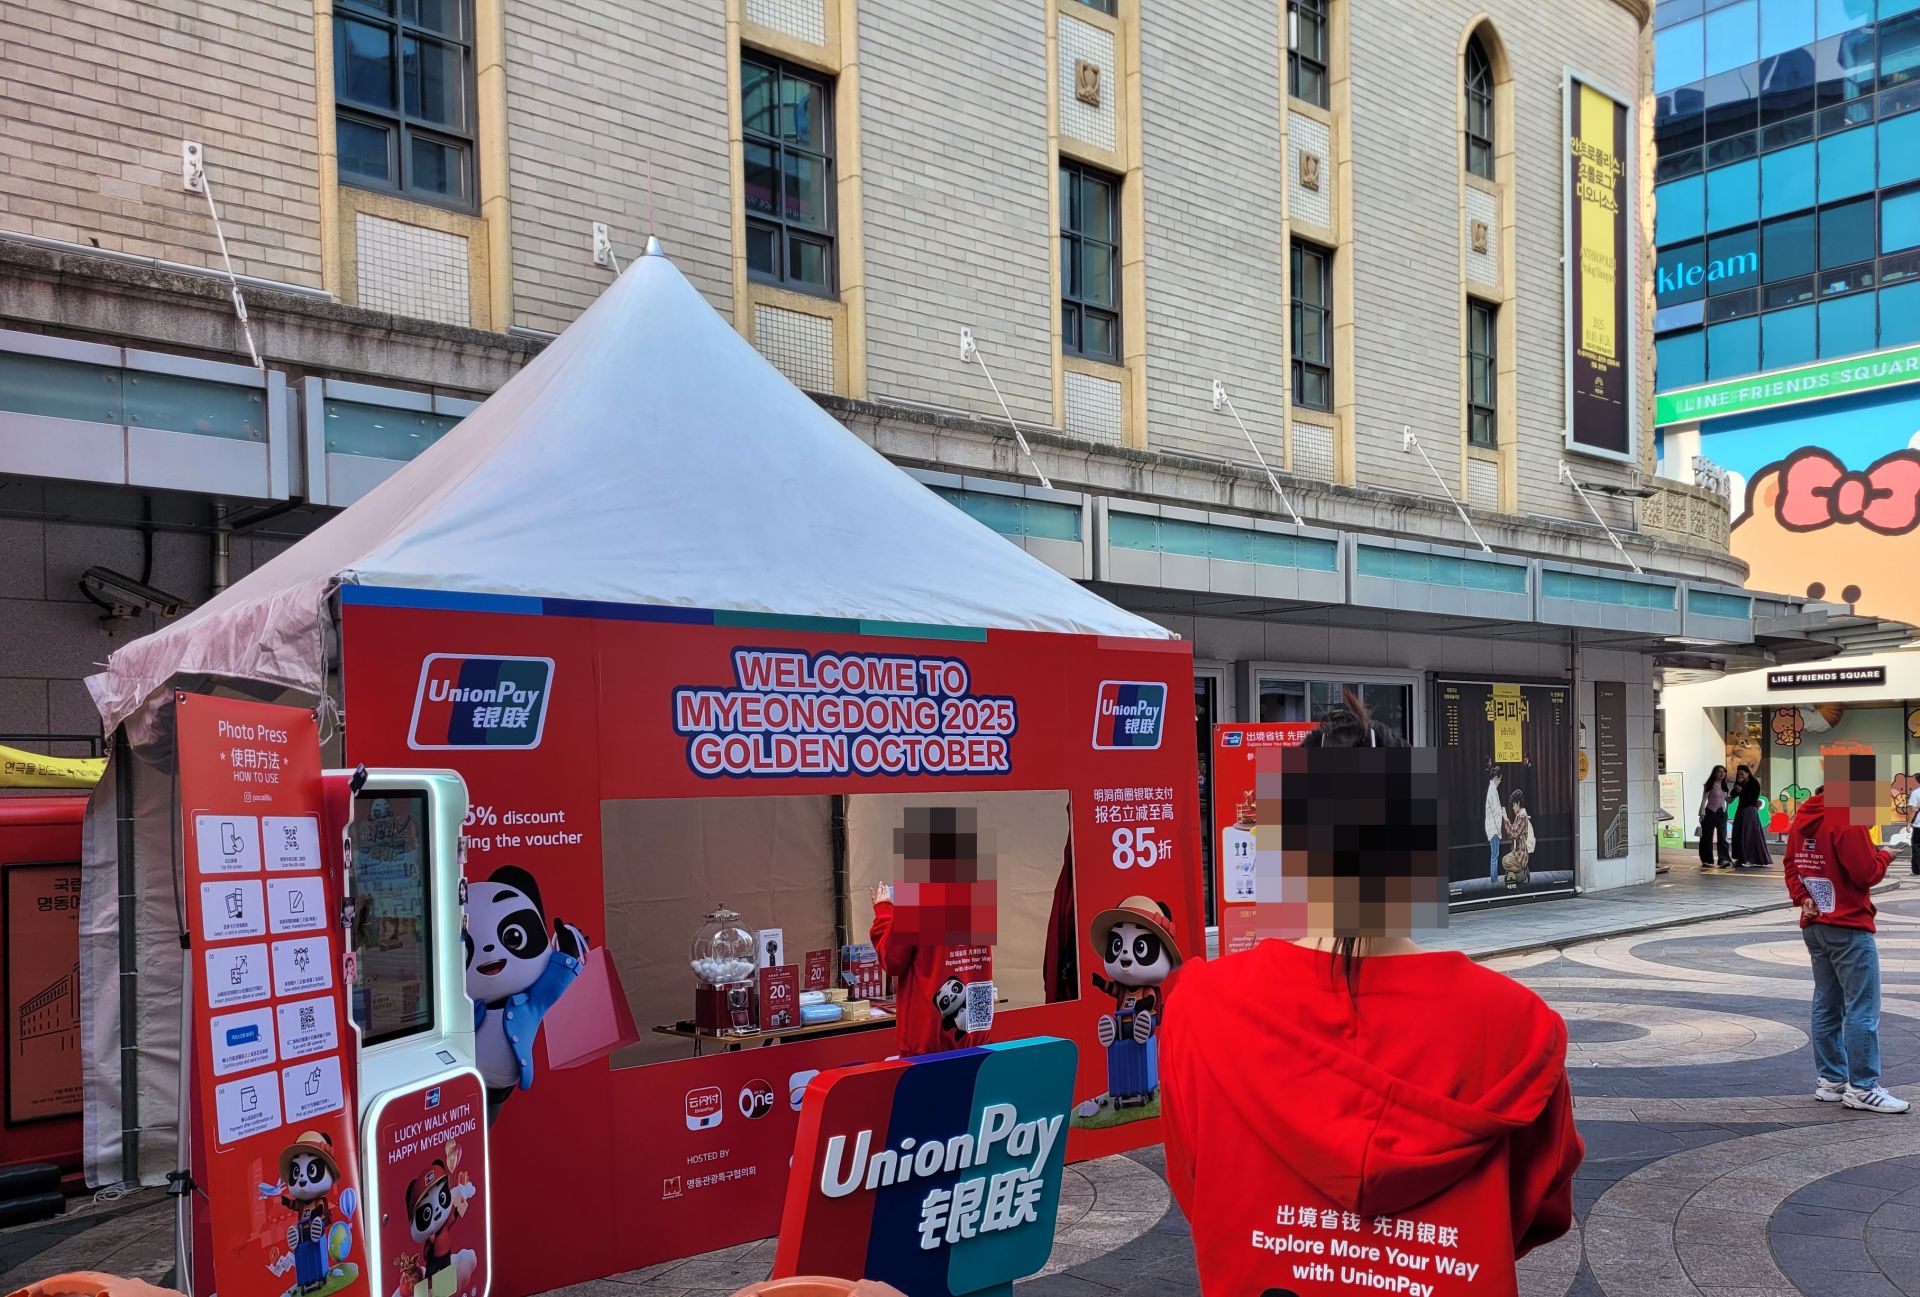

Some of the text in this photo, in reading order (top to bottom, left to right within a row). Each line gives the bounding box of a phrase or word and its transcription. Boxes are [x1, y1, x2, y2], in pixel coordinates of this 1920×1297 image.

[1658, 252, 1757, 293] kleam
[1683, 391, 1732, 412] LINE
[1739, 374, 1830, 400] FRIENDS
[738, 653, 966, 695] WELCOME TO
[1772, 671, 1880, 683] LINE FRIENDS SQUARE
[429, 680, 540, 712] UnionPay
[472, 707, 530, 728] 银联
[679, 694, 1014, 732] MYEONGDONG 2025
[1102, 699, 1160, 722] UnionPay
[1485, 700, 1530, 722] 젤리피쉬
[218, 720, 288, 744] Photo Press
[1125, 718, 1155, 734] 银联
[1246, 731, 1285, 741] 出境省钱
[231, 747, 280, 769] 使用方法
[693, 737, 1008, 770] GOLDEN OCTOBER
[5, 761, 36, 776] 연극을
[233, 771, 279, 784] HOW TO USE
[1093, 787, 1174, 802] 明洞商圈银联支付
[502, 810, 565, 825] discount
[1095, 803, 1174, 823] 报名立减至高
[496, 834, 521, 848] the
[525, 831, 583, 846] voucher
[1112, 827, 1173, 869] 85折
[394, 1103, 470, 1143] LUCKY WALK WITH
[388, 1118, 476, 1164] HAPPY MYEONGDONG
[821, 1103, 1065, 1198] UnionPay
[687, 1149, 730, 1165] HOSTED BY
[687, 1166, 756, 1189] 명동관광특구협의회
[919, 1168, 1044, 1250] 银联
[1276, 1205, 1459, 1248] 出境省钱 先用银联
[1252, 1230, 1480, 1282] Explore More Your Way
[1292, 1262, 1434, 1297] with UnionPay
